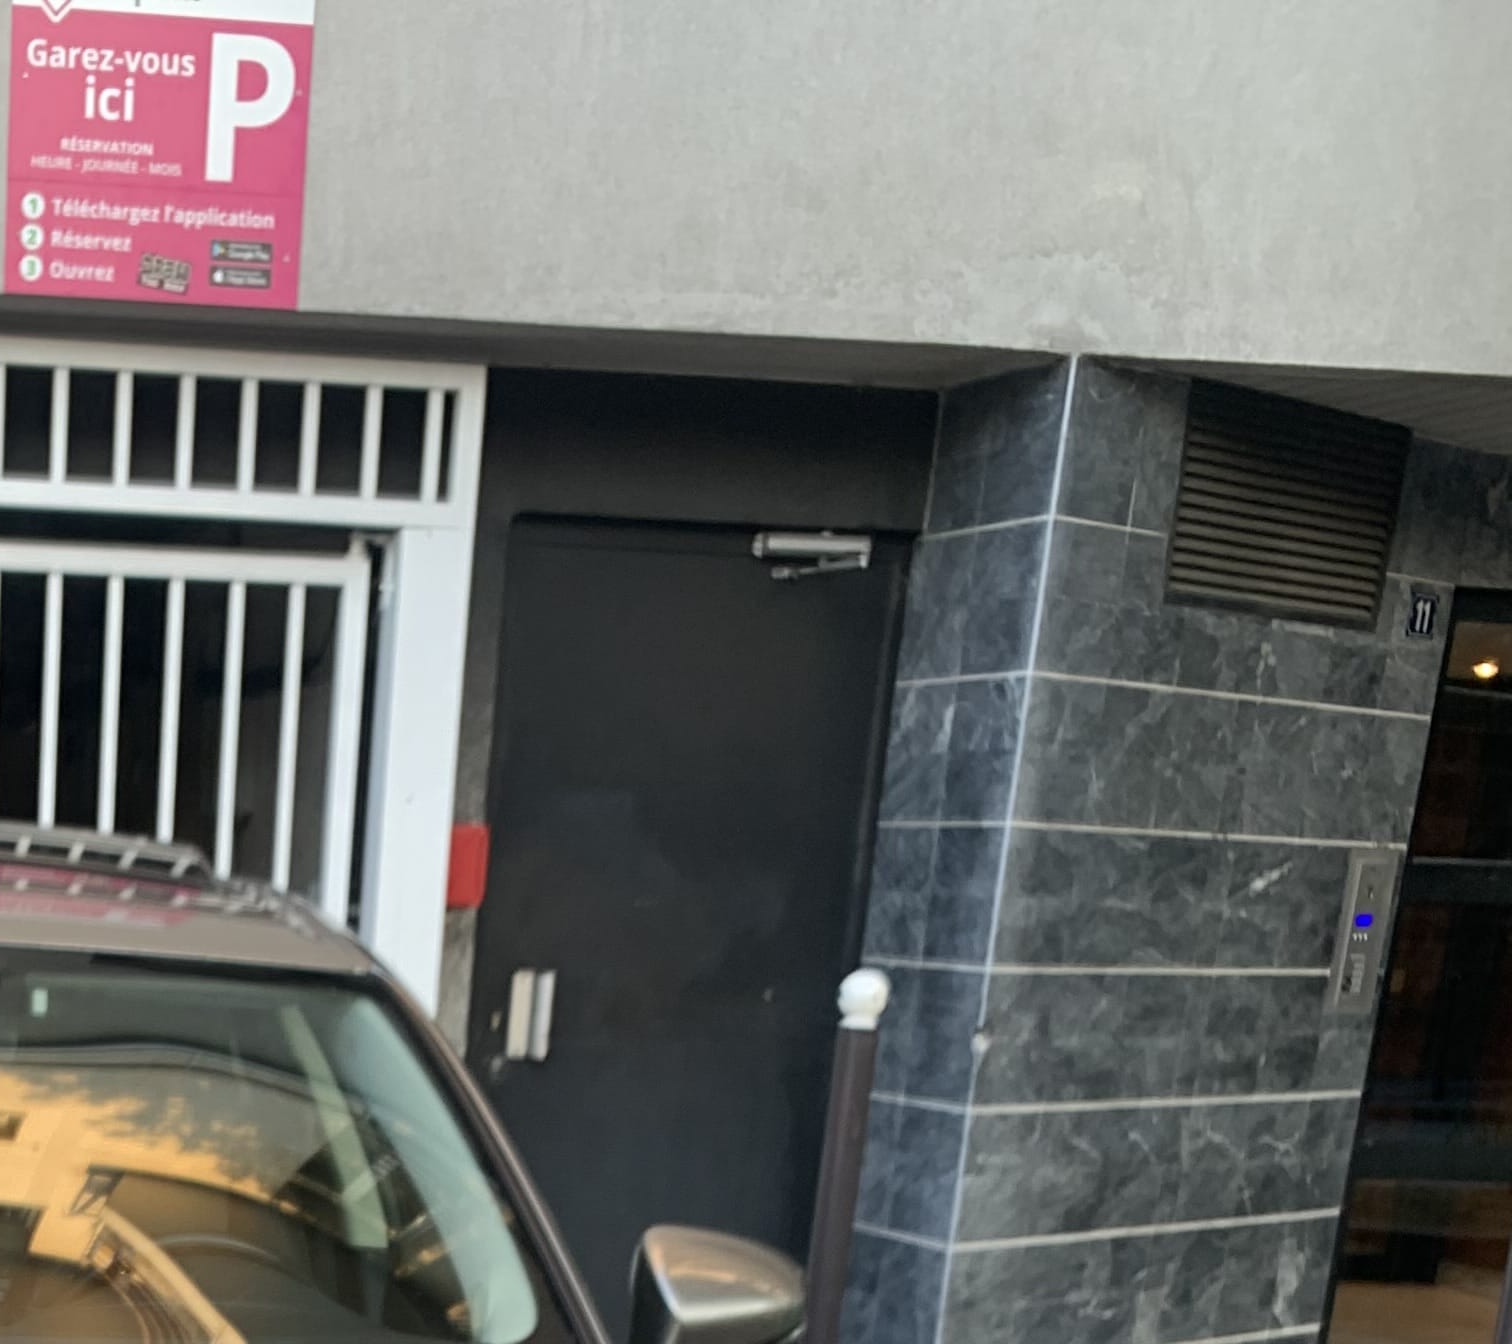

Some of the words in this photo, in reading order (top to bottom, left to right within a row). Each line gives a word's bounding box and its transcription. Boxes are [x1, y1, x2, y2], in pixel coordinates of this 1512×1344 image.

[27, 38, 196, 77] Garez-vous
[84, 75, 135, 121] ici
[205, 32, 296, 182] P
[60, 136, 154, 156] RÉSERVATION
[52, 197, 160, 226] Téléchargez
[164, 205, 275, 229] l'application
[26, 229, 36, 245] 2
[51, 229, 132, 252] Réservez
[49, 261, 115, 282] Ouvrez
[1415, 600, 1431, 633] 11
